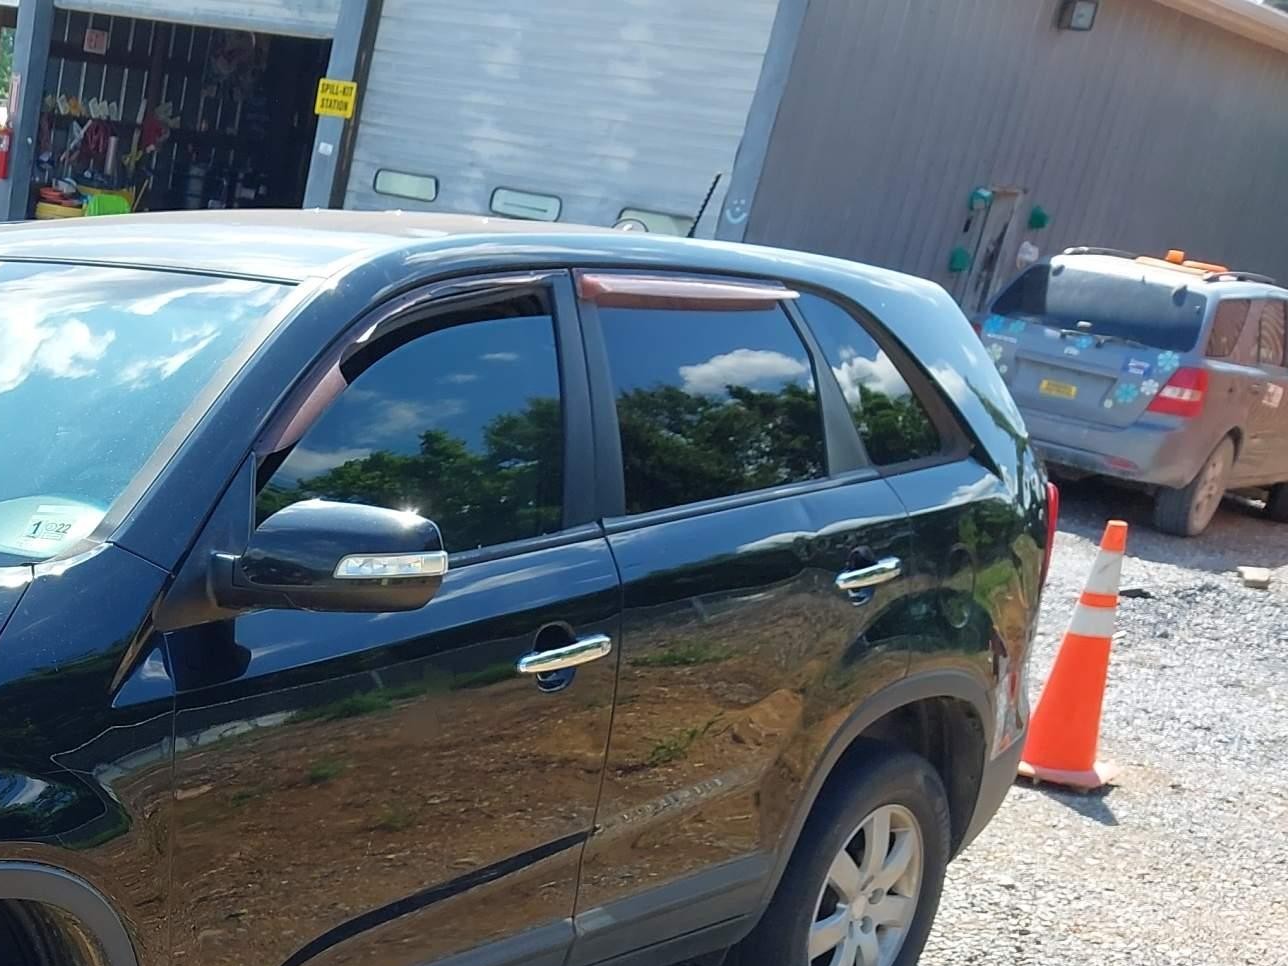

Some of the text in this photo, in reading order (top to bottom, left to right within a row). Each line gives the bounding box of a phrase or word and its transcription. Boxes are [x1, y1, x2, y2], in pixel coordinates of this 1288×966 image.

[320, 82, 354, 97] SPILL-KIT
[320, 98, 349, 112] STATION
[55, 522, 72, 534] 22
